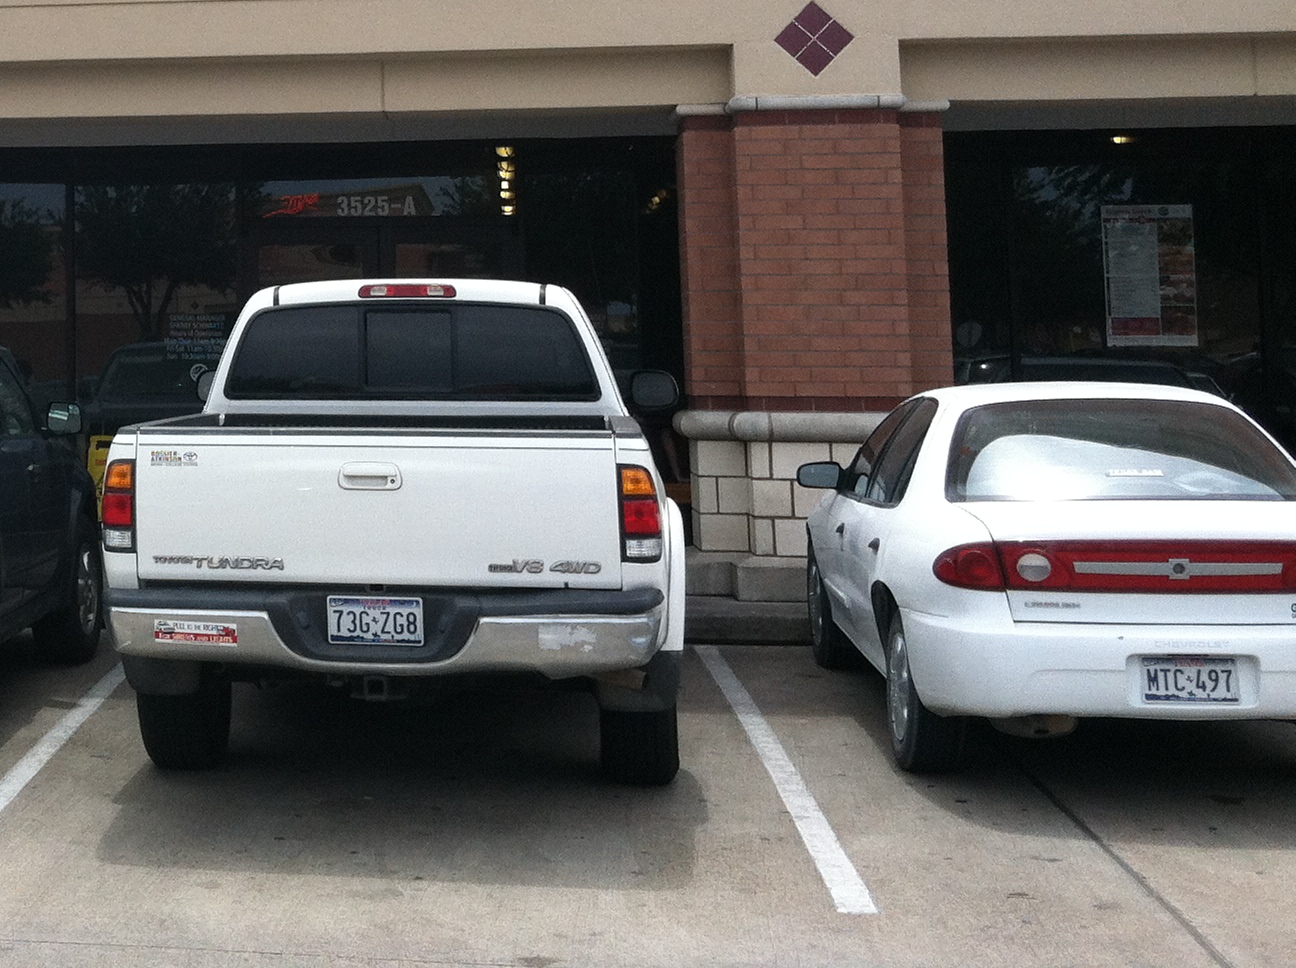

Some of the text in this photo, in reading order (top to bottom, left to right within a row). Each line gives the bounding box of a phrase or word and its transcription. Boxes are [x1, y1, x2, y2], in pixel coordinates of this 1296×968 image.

[336, 195, 417, 216] 3525-A
[192, 555, 285, 571] TUNDRA
[512, 559, 544, 574] V8
[549, 560, 602, 574] 4WD
[332, 609, 418, 635] 73G ZG8
[1146, 668, 1233, 693] MTC 497
